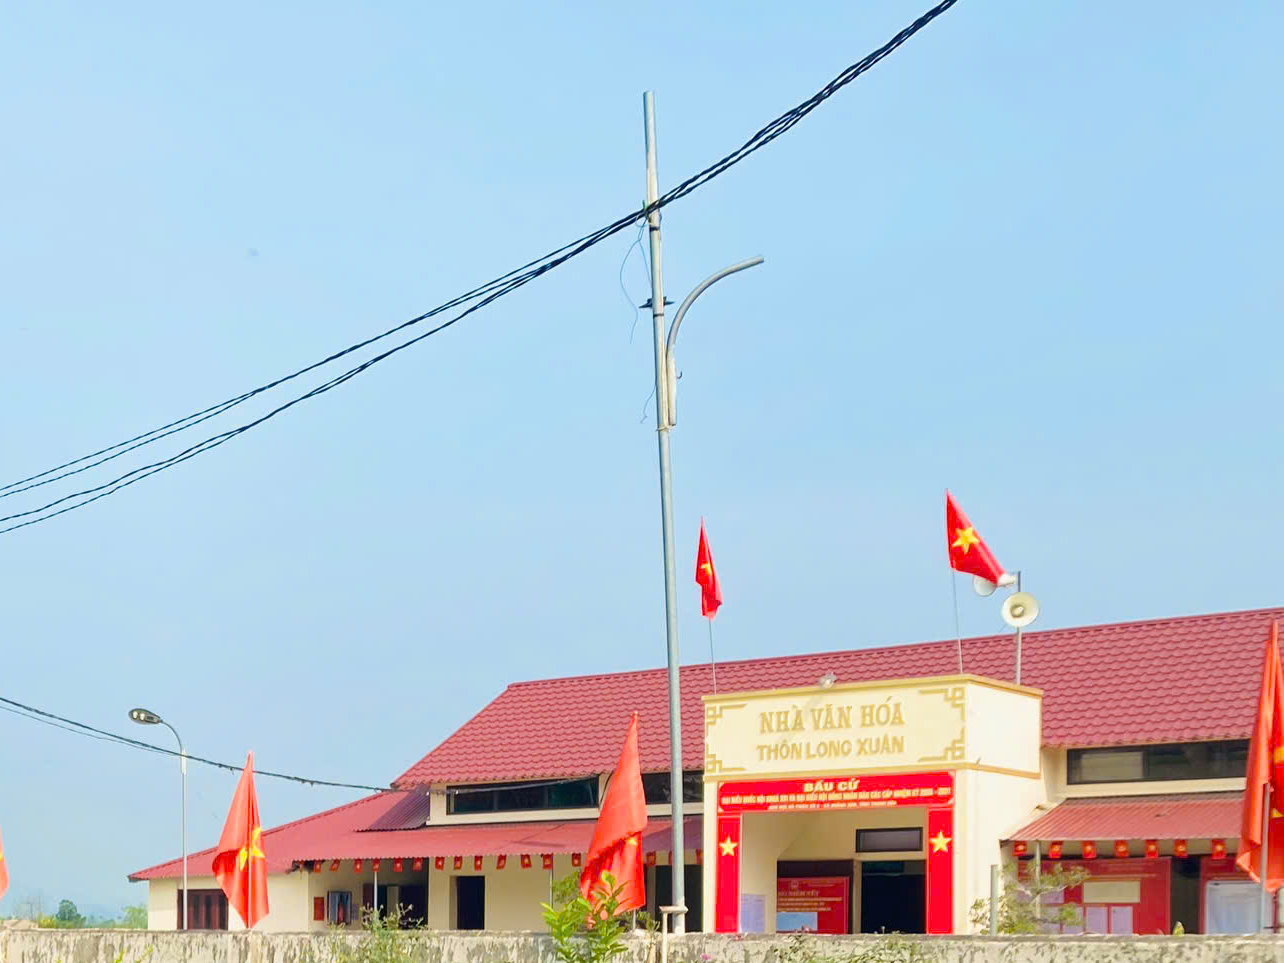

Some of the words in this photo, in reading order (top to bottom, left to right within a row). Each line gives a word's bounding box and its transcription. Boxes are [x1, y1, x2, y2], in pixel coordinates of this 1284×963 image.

[759, 704, 805, 734] NHÀ
[810, 704, 852, 730] VĂN
[860, 696, 905, 728] HÓA
[756, 739, 803, 760] THÔN
[856, 734, 904, 755] XUÂN
